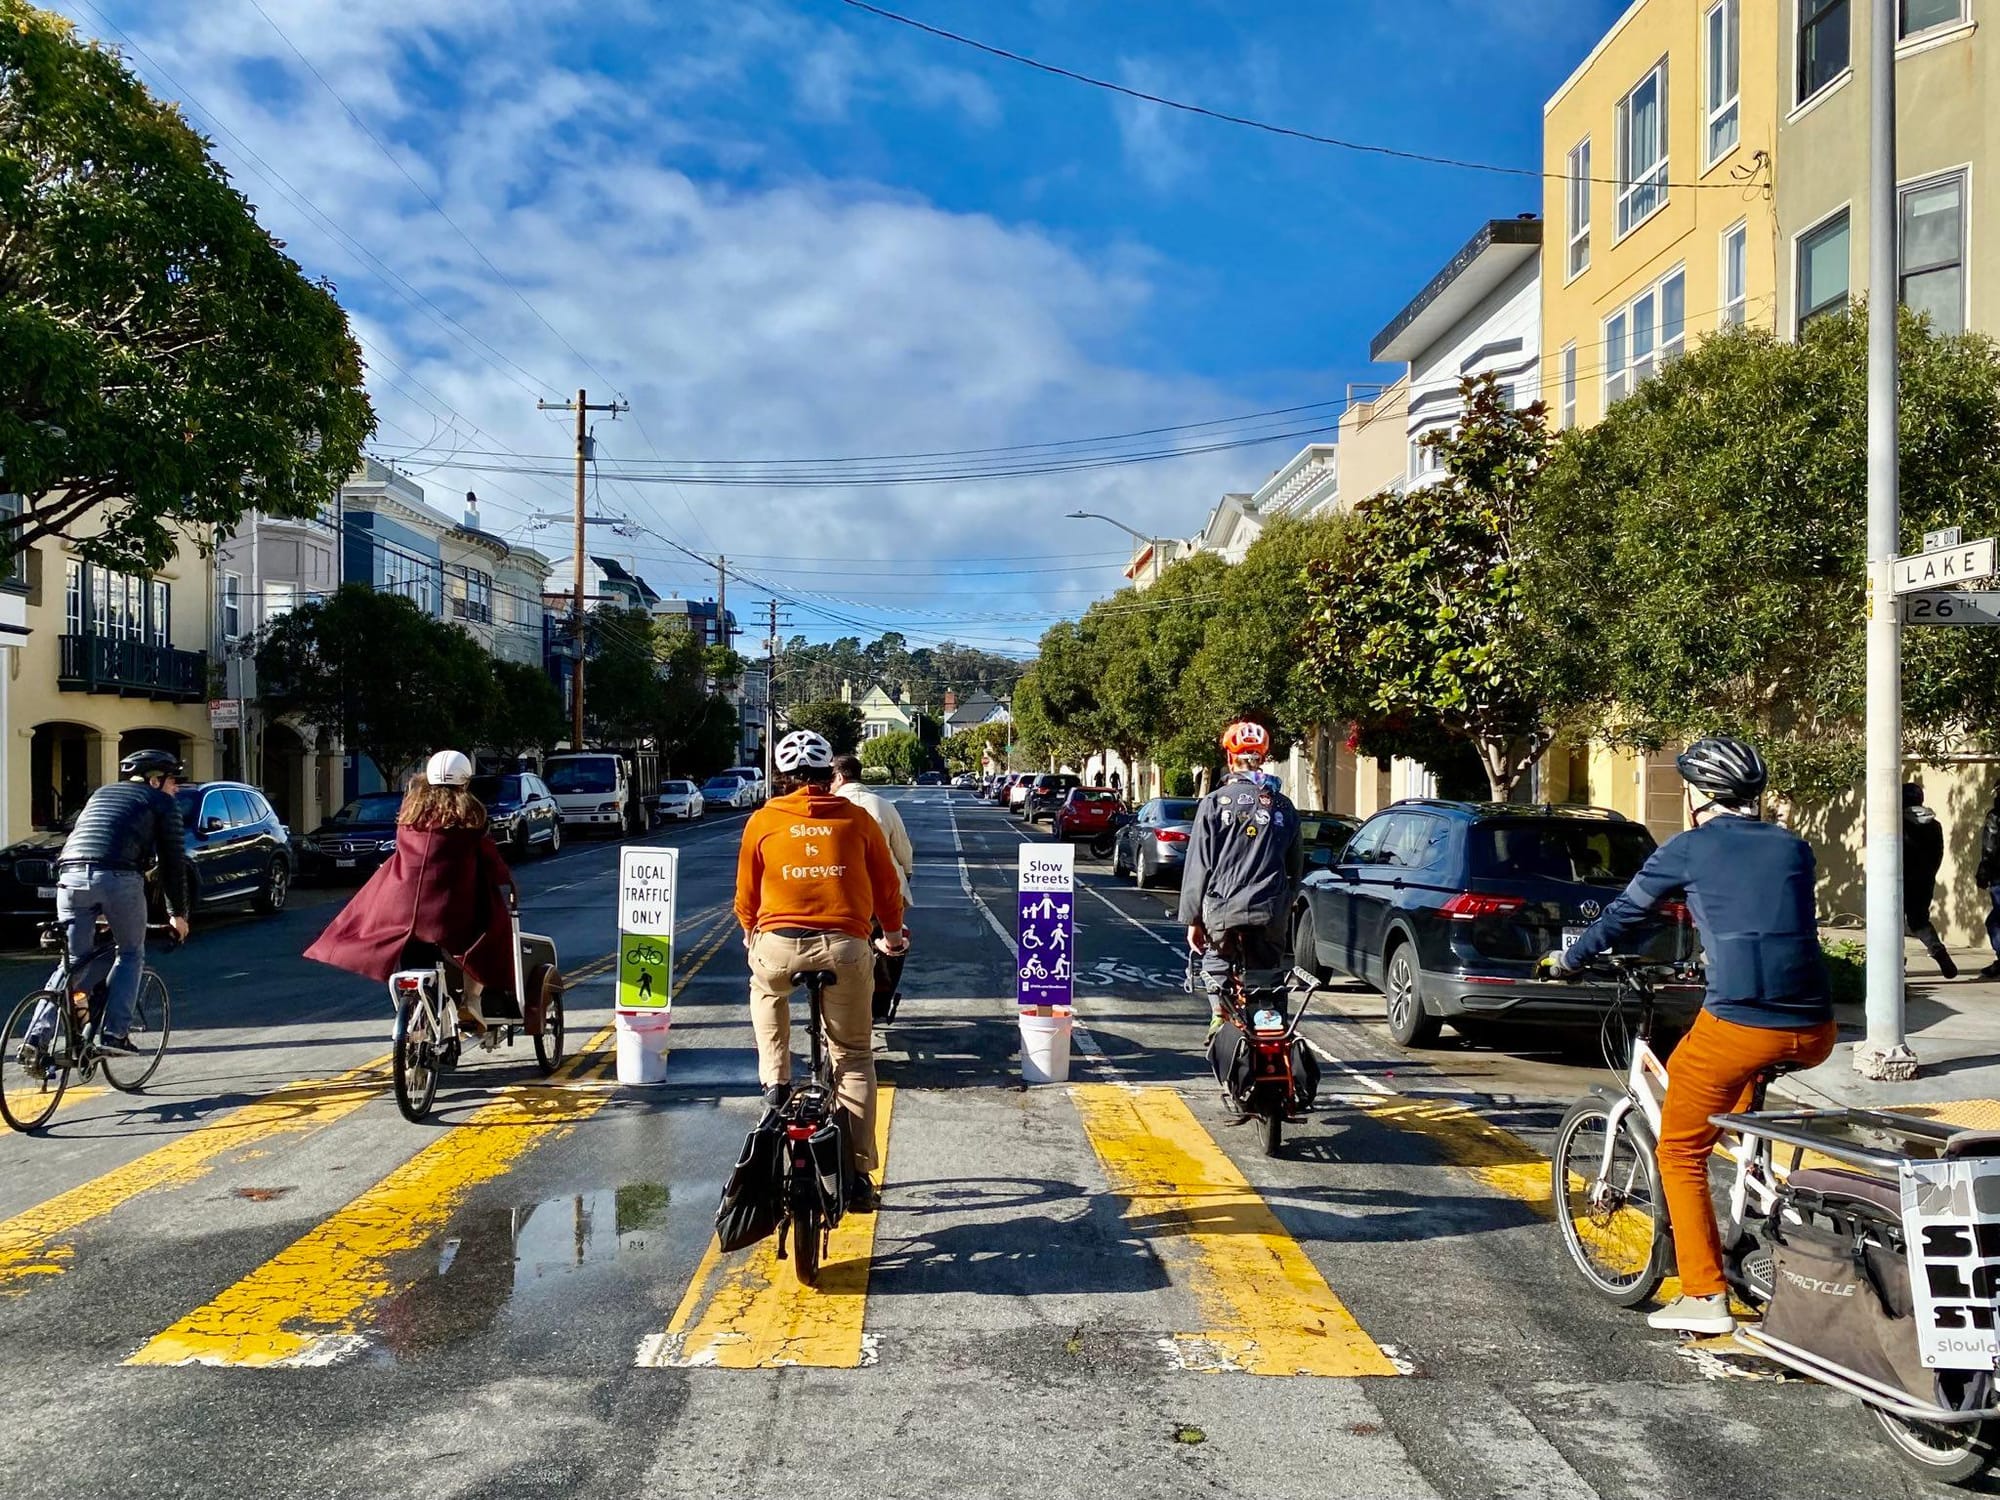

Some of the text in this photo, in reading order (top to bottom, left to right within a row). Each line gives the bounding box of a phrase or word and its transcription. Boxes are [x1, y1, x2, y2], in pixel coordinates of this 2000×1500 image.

[1907, 552, 1975, 584] LAKE
[790, 824, 833, 838] Slow
[805, 843, 819, 857] is
[631, 865, 665, 879] LOCAL
[782, 864, 846, 880] Forever
[1030, 860, 1063, 871] Slow
[1023, 873, 1069, 884] Streets
[625, 888, 669, 902] TRAFFIC
[632, 910, 661, 924] ONLY
